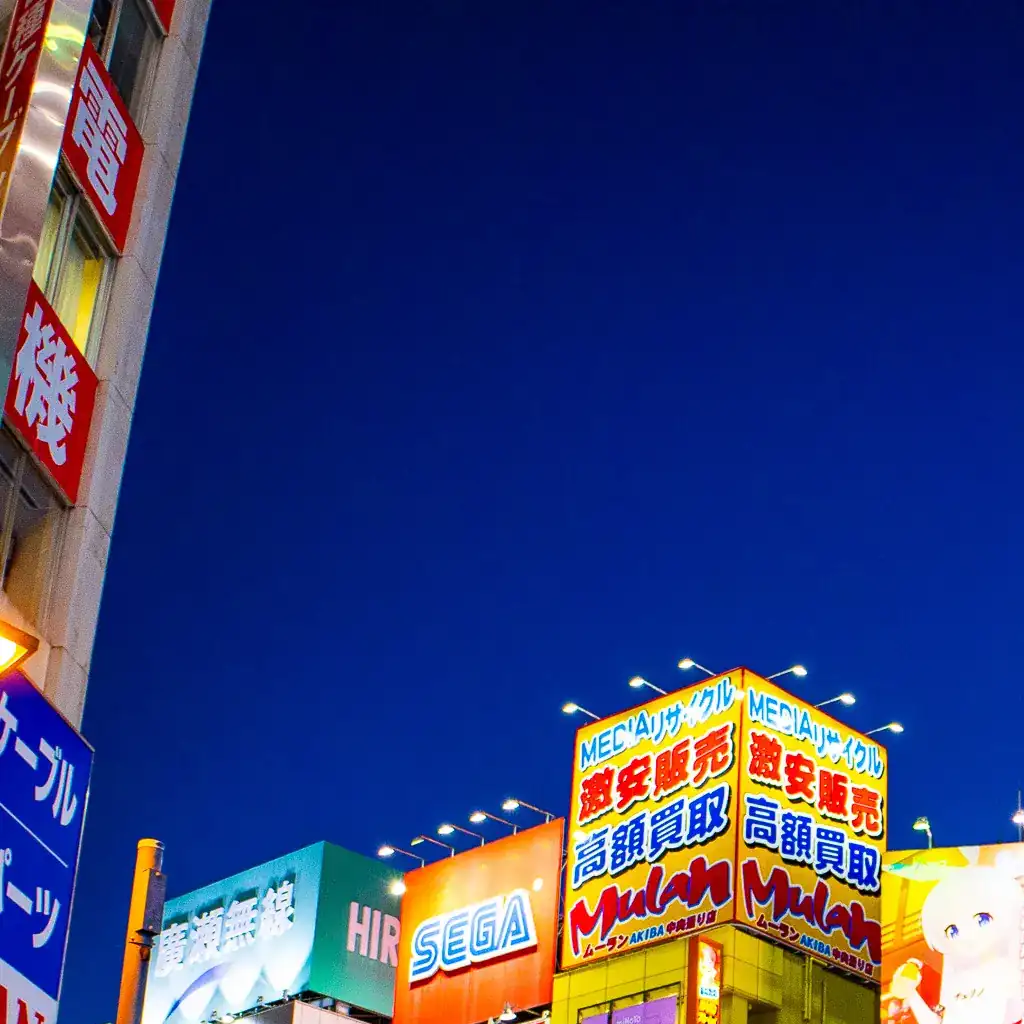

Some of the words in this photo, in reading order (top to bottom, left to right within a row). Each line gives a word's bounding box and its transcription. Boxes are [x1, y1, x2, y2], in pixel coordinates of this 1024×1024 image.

[71, 56, 128, 216] 電
[14, 302, 78, 467] 機
[577, 722, 735, 825] 激安販売
[748, 731, 884, 837] 激安販売
[572, 785, 731, 889] 高額買取
[743, 794, 881, 892] 高額買取
[409, 888, 538, 983] SEGA
[569, 857, 732, 956] Mulan
[583, 934, 630, 959] ムーラン
[629, 926, 664, 945] AKIBA
[741, 859, 883, 966] Mulan
[756, 917, 800, 944] ムーラン
[800, 933, 831, 958] AKIBA
